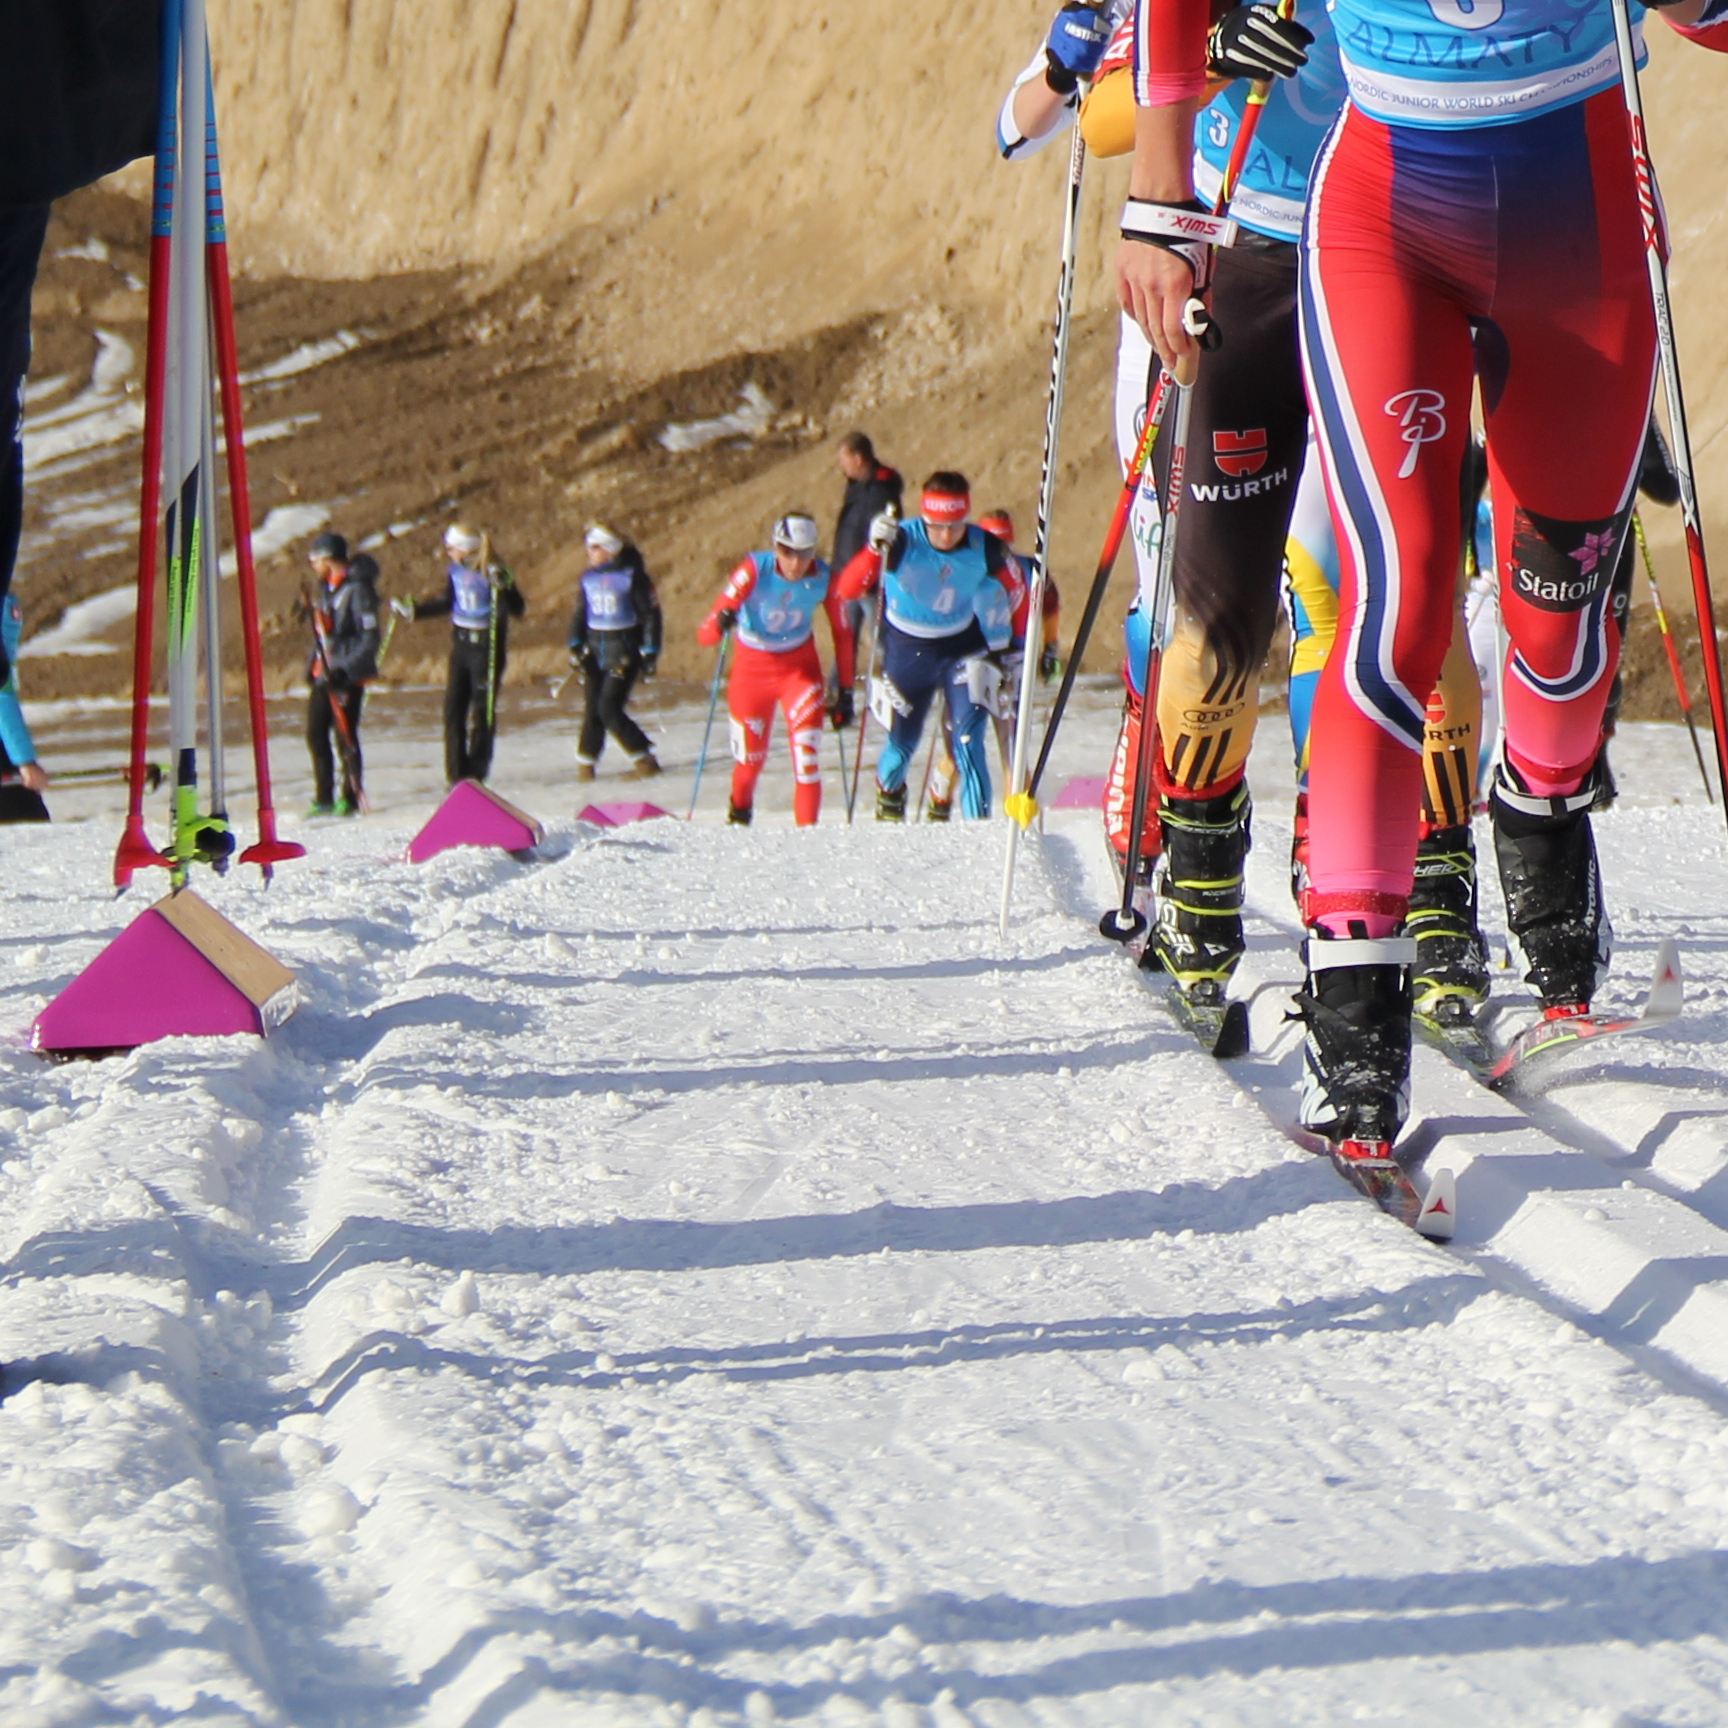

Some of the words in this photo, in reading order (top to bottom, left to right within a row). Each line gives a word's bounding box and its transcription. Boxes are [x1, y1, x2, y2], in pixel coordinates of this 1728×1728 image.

[1347, 21, 1580, 70] ALMATY
[1349, 76, 1390, 103] NORDIC
[1391, 92, 1441, 110] JUNIOR
[1442, 95, 1495, 110] WORLD
[1497, 93, 1518, 108] SKI
[1208, 107, 1231, 149] 3
[1239, 196, 1282, 219] NORDIC
[1190, 467, 1288, 503] WÜRTH
[924, 498, 966, 512] LUKOIL
[1518, 568, 1600, 602] Statoil
[1584, 859, 1597, 929] ATOMIC
